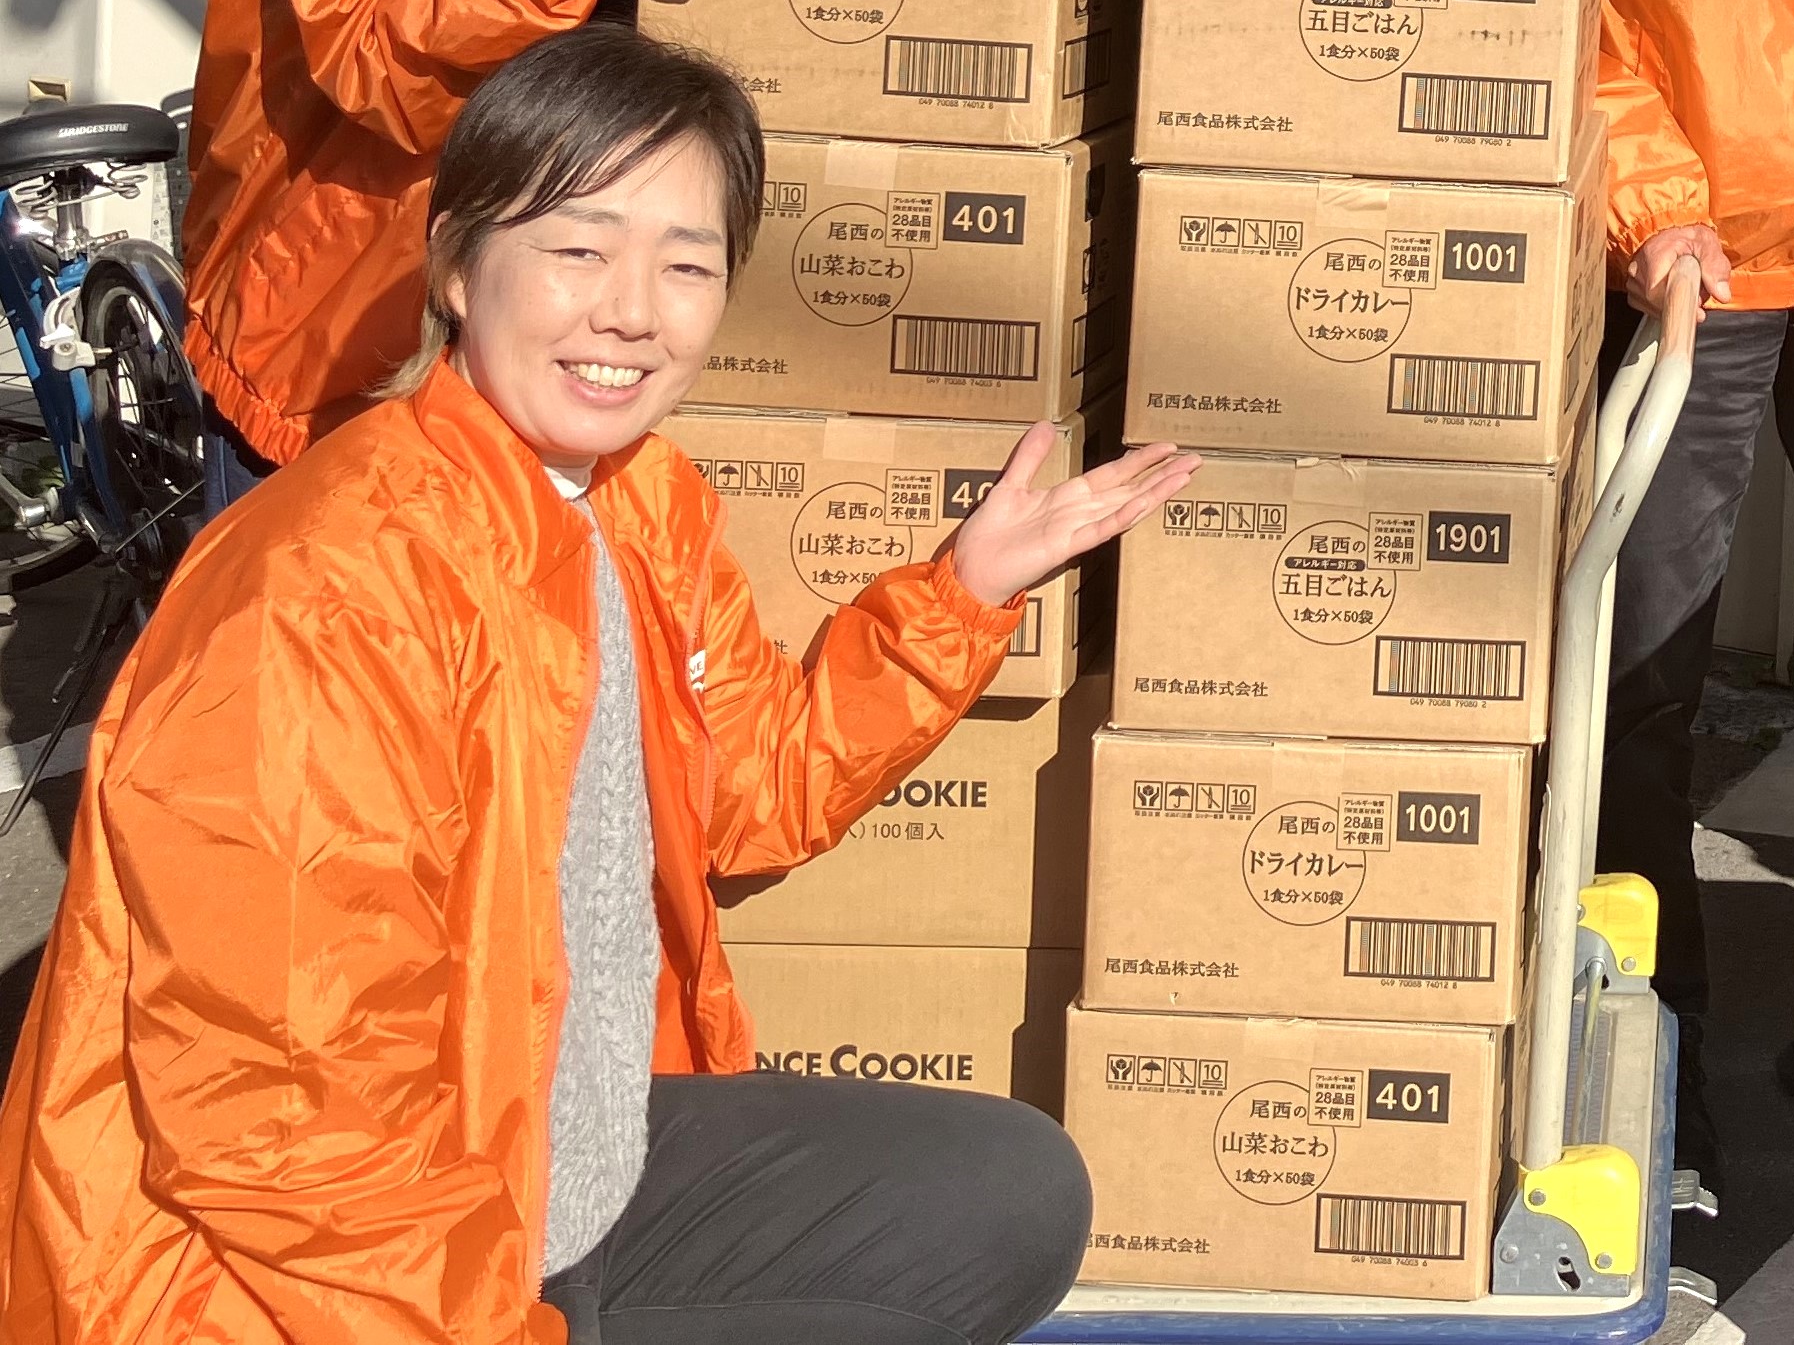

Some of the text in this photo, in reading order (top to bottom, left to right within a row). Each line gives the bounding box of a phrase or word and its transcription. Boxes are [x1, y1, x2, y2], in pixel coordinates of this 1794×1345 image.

[1304, 8, 1419, 36] 五目ごはん
[1156, 110, 1293, 132] 尾西食品株式会社
[782, 186, 801, 203] 10
[892, 214, 931, 228] 28品目
[951, 204, 1016, 234] 401
[827, 221, 884, 242] 尾西の
[891, 229, 930, 243] 不使用
[1277, 225, 1297, 242] 10
[799, 252, 906, 278] 山菜おこわ
[1323, 252, 1382, 273] 尾西の
[1390, 253, 1430, 267] 28品目
[1451, 241, 1516, 273] 1001
[1389, 268, 1429, 283] 不使用
[1293, 286, 1409, 316] ドライカレー
[1146, 392, 1282, 413] 尾西食品株式会社
[780, 467, 800, 483] 10
[891, 492, 930, 504] 28品目
[825, 500, 883, 520] 尾西の
[891, 507, 930, 520] 不使用
[1262, 508, 1281, 525] 10
[798, 532, 905, 556] 山菜おこわ
[1308, 535, 1365, 555] 尾西の
[1374, 535, 1414, 549] 28品目
[1434, 523, 1501, 553] 1901
[1293, 558, 1357, 570] アレルギー対応
[1373, 550, 1413, 564] 不使用
[811, 569, 877, 584] 1食分×50
[1278, 572, 1392, 599] 五目ごはん
[1133, 677, 1268, 697] 尾西食品株式会社
[1231, 789, 1250, 806] 10
[1277, 815, 1335, 835] 尾西の
[1343, 816, 1383, 829] 28品目
[1404, 803, 1470, 834] 1001
[1343, 831, 1383, 845] 不使用
[1248, 849, 1364, 879] ドライカレー
[1104, 957, 1239, 977] 尾西食品株式会社
[830, 1044, 973, 1080] COOKIE
[1203, 1064, 1222, 1081] 10
[1315, 1092, 1355, 1106] 28品目
[1375, 1082, 1440, 1112] 401
[1249, 1099, 1307, 1120] 尾西の
[1314, 1107, 1354, 1121] 不使用
[1221, 1130, 1329, 1157] 山菜おこわ
